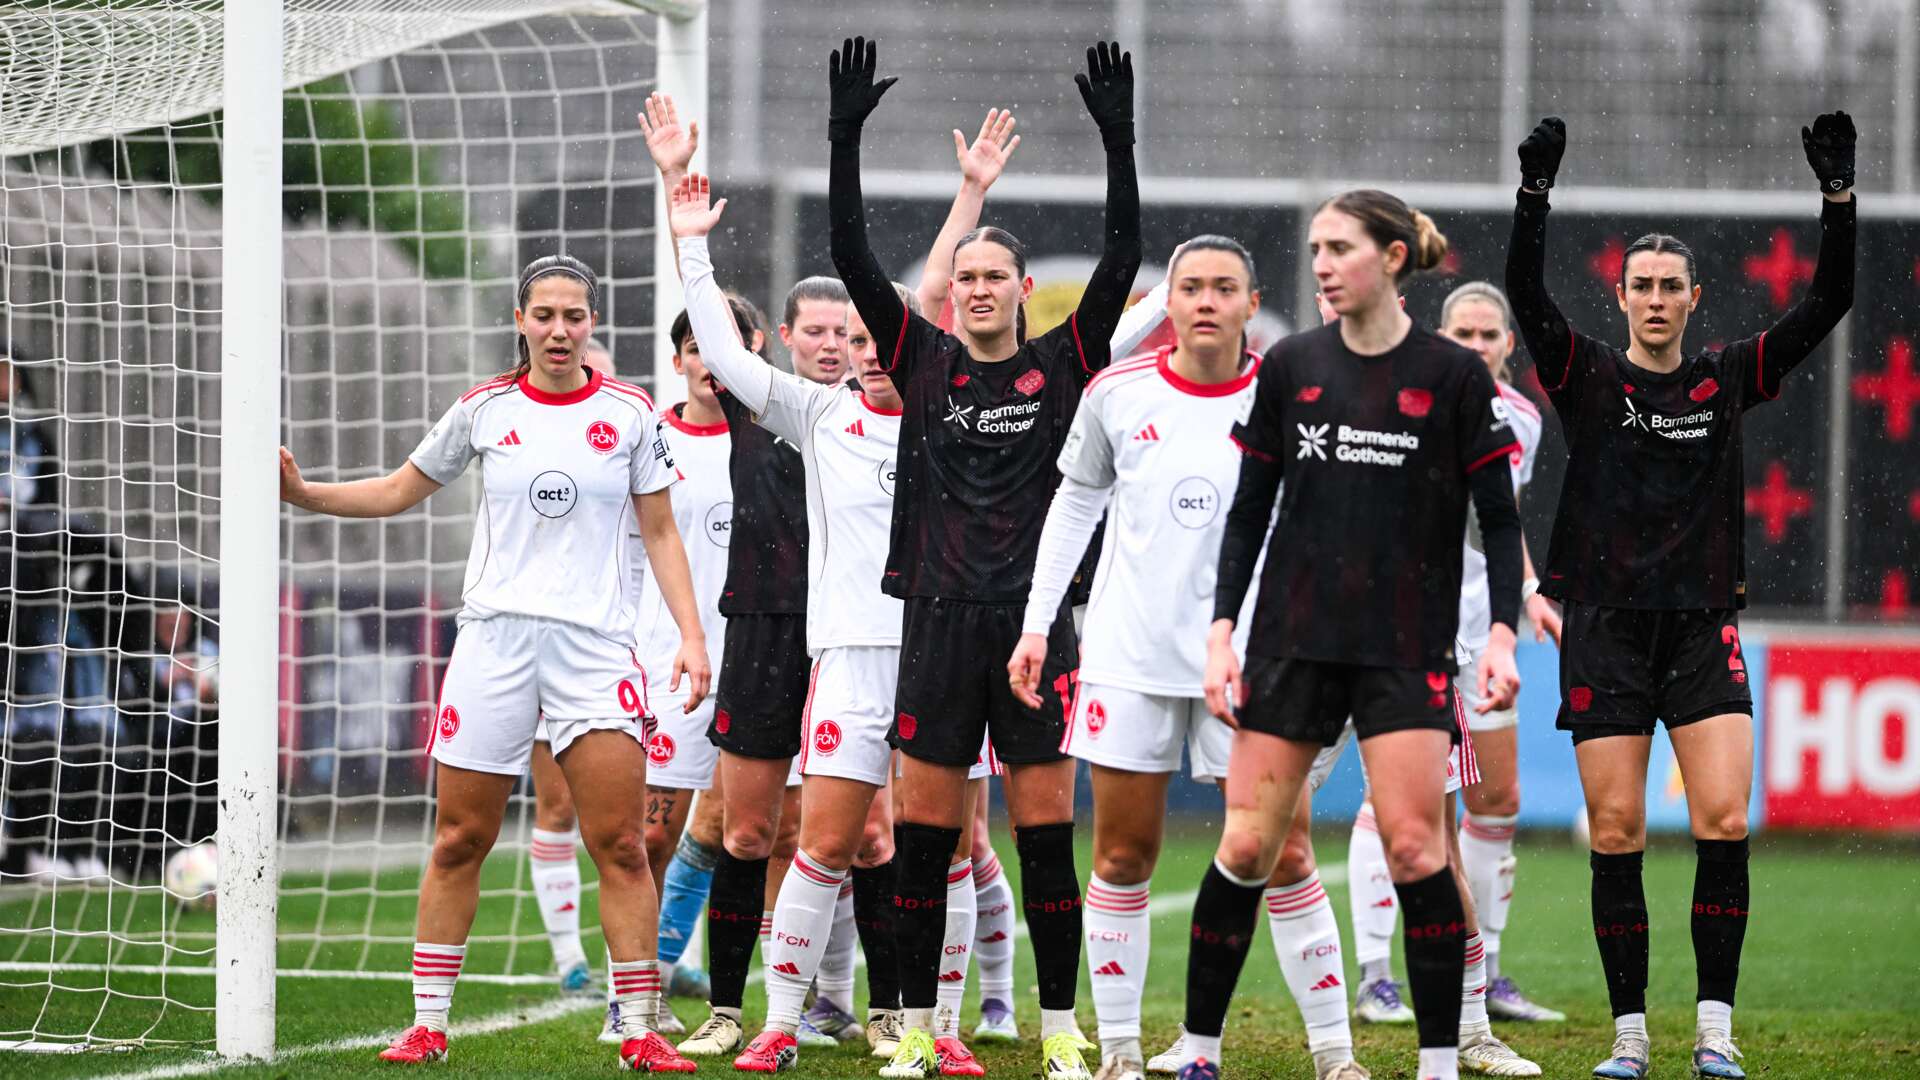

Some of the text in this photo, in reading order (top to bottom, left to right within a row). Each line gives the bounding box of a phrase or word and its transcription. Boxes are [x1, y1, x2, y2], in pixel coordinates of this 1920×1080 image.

[980, 402, 1041, 420] Barmenia
[1652, 409, 1713, 428] Barmenia
[977, 417, 1035, 433] Gothaer
[591, 433, 615, 444] FCN
[1337, 425, 1419, 449] Barmenia
[1335, 444, 1406, 466] Gothaer
[1721, 625, 1745, 670] 2
[617, 679, 646, 718] 9
[441, 718, 457, 731] FCN
[816, 733, 837, 745] FCN
[1769, 675, 1920, 798] HO
[649, 744, 672, 758] FCN
[777, 932, 810, 948] FCN
[1089, 931, 1129, 943] FCN
[945, 944, 967, 956] CN
[1302, 944, 1338, 961] FCN
